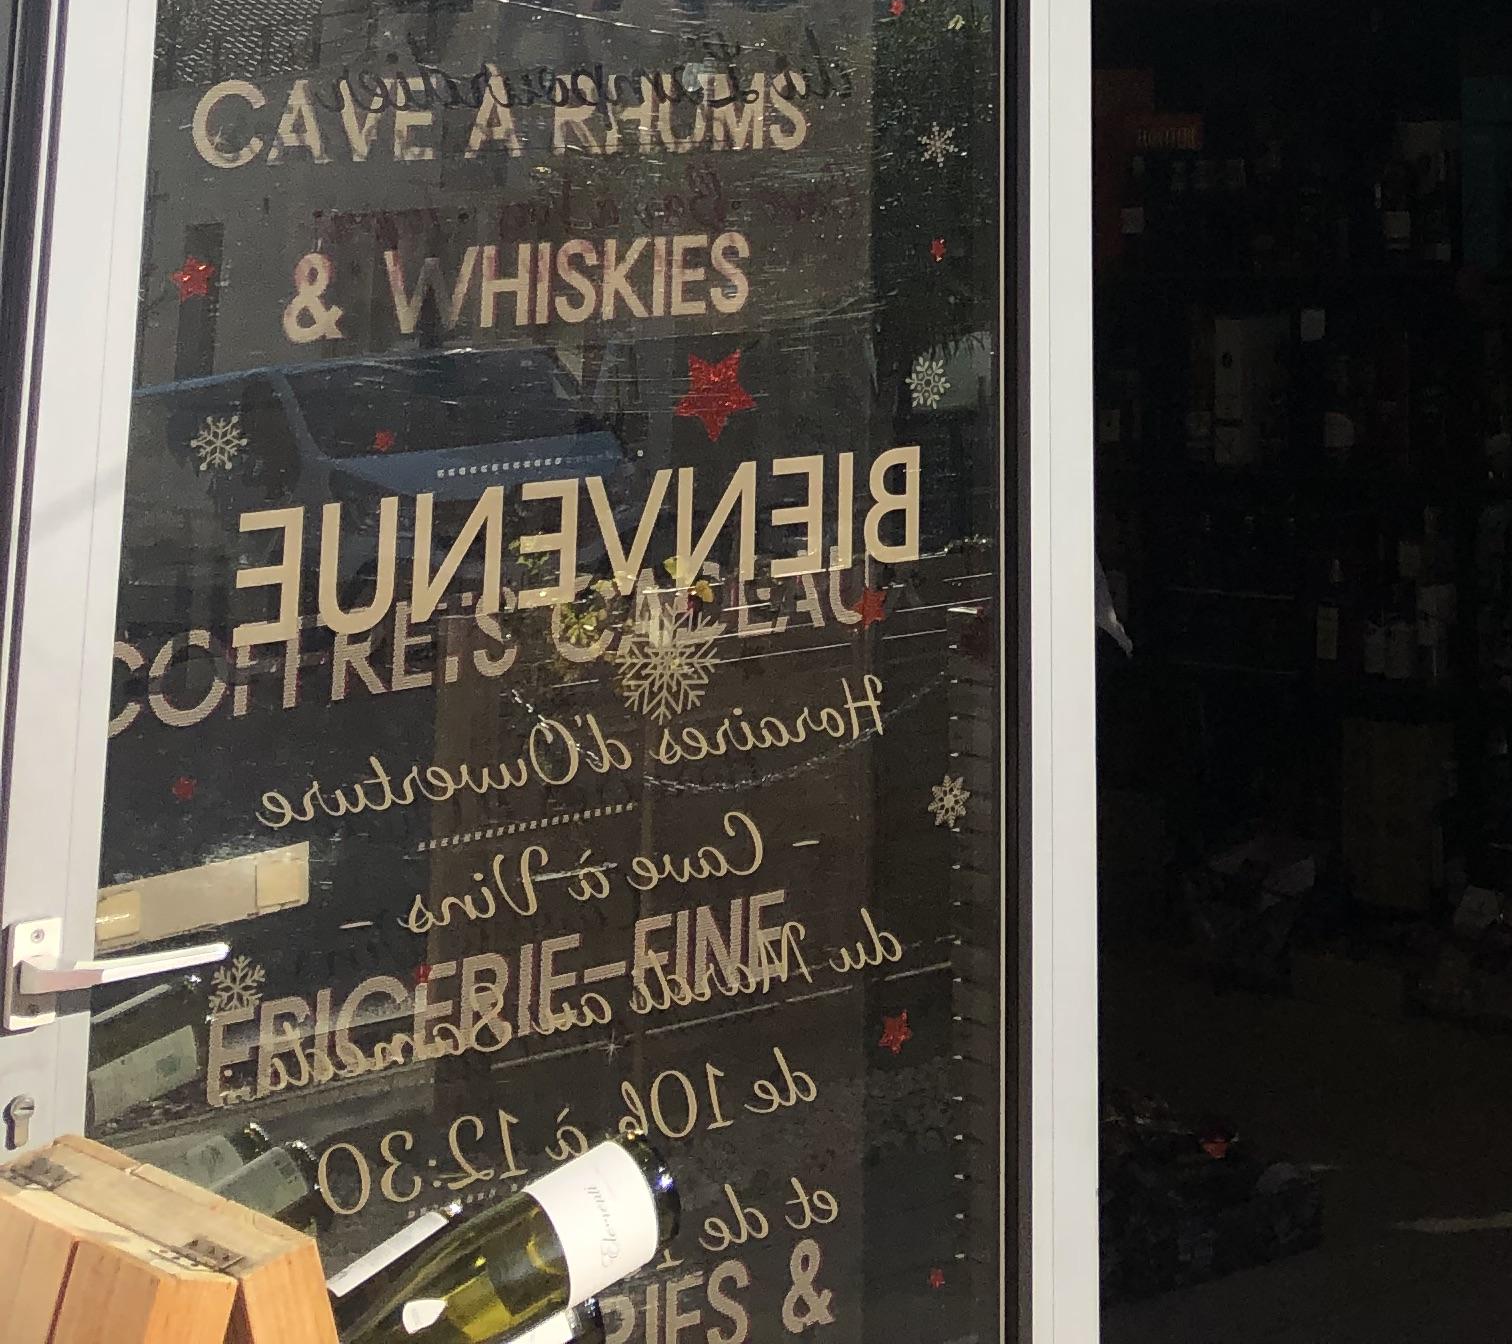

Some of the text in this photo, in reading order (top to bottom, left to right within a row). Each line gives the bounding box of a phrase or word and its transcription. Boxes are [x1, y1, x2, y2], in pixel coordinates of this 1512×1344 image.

[191, 78, 436, 169] CAVE
[552, 70, 812, 156] RHUMS
[283, 232, 752, 344] & WHISKIES
[781, 1238, 837, 1334] &
